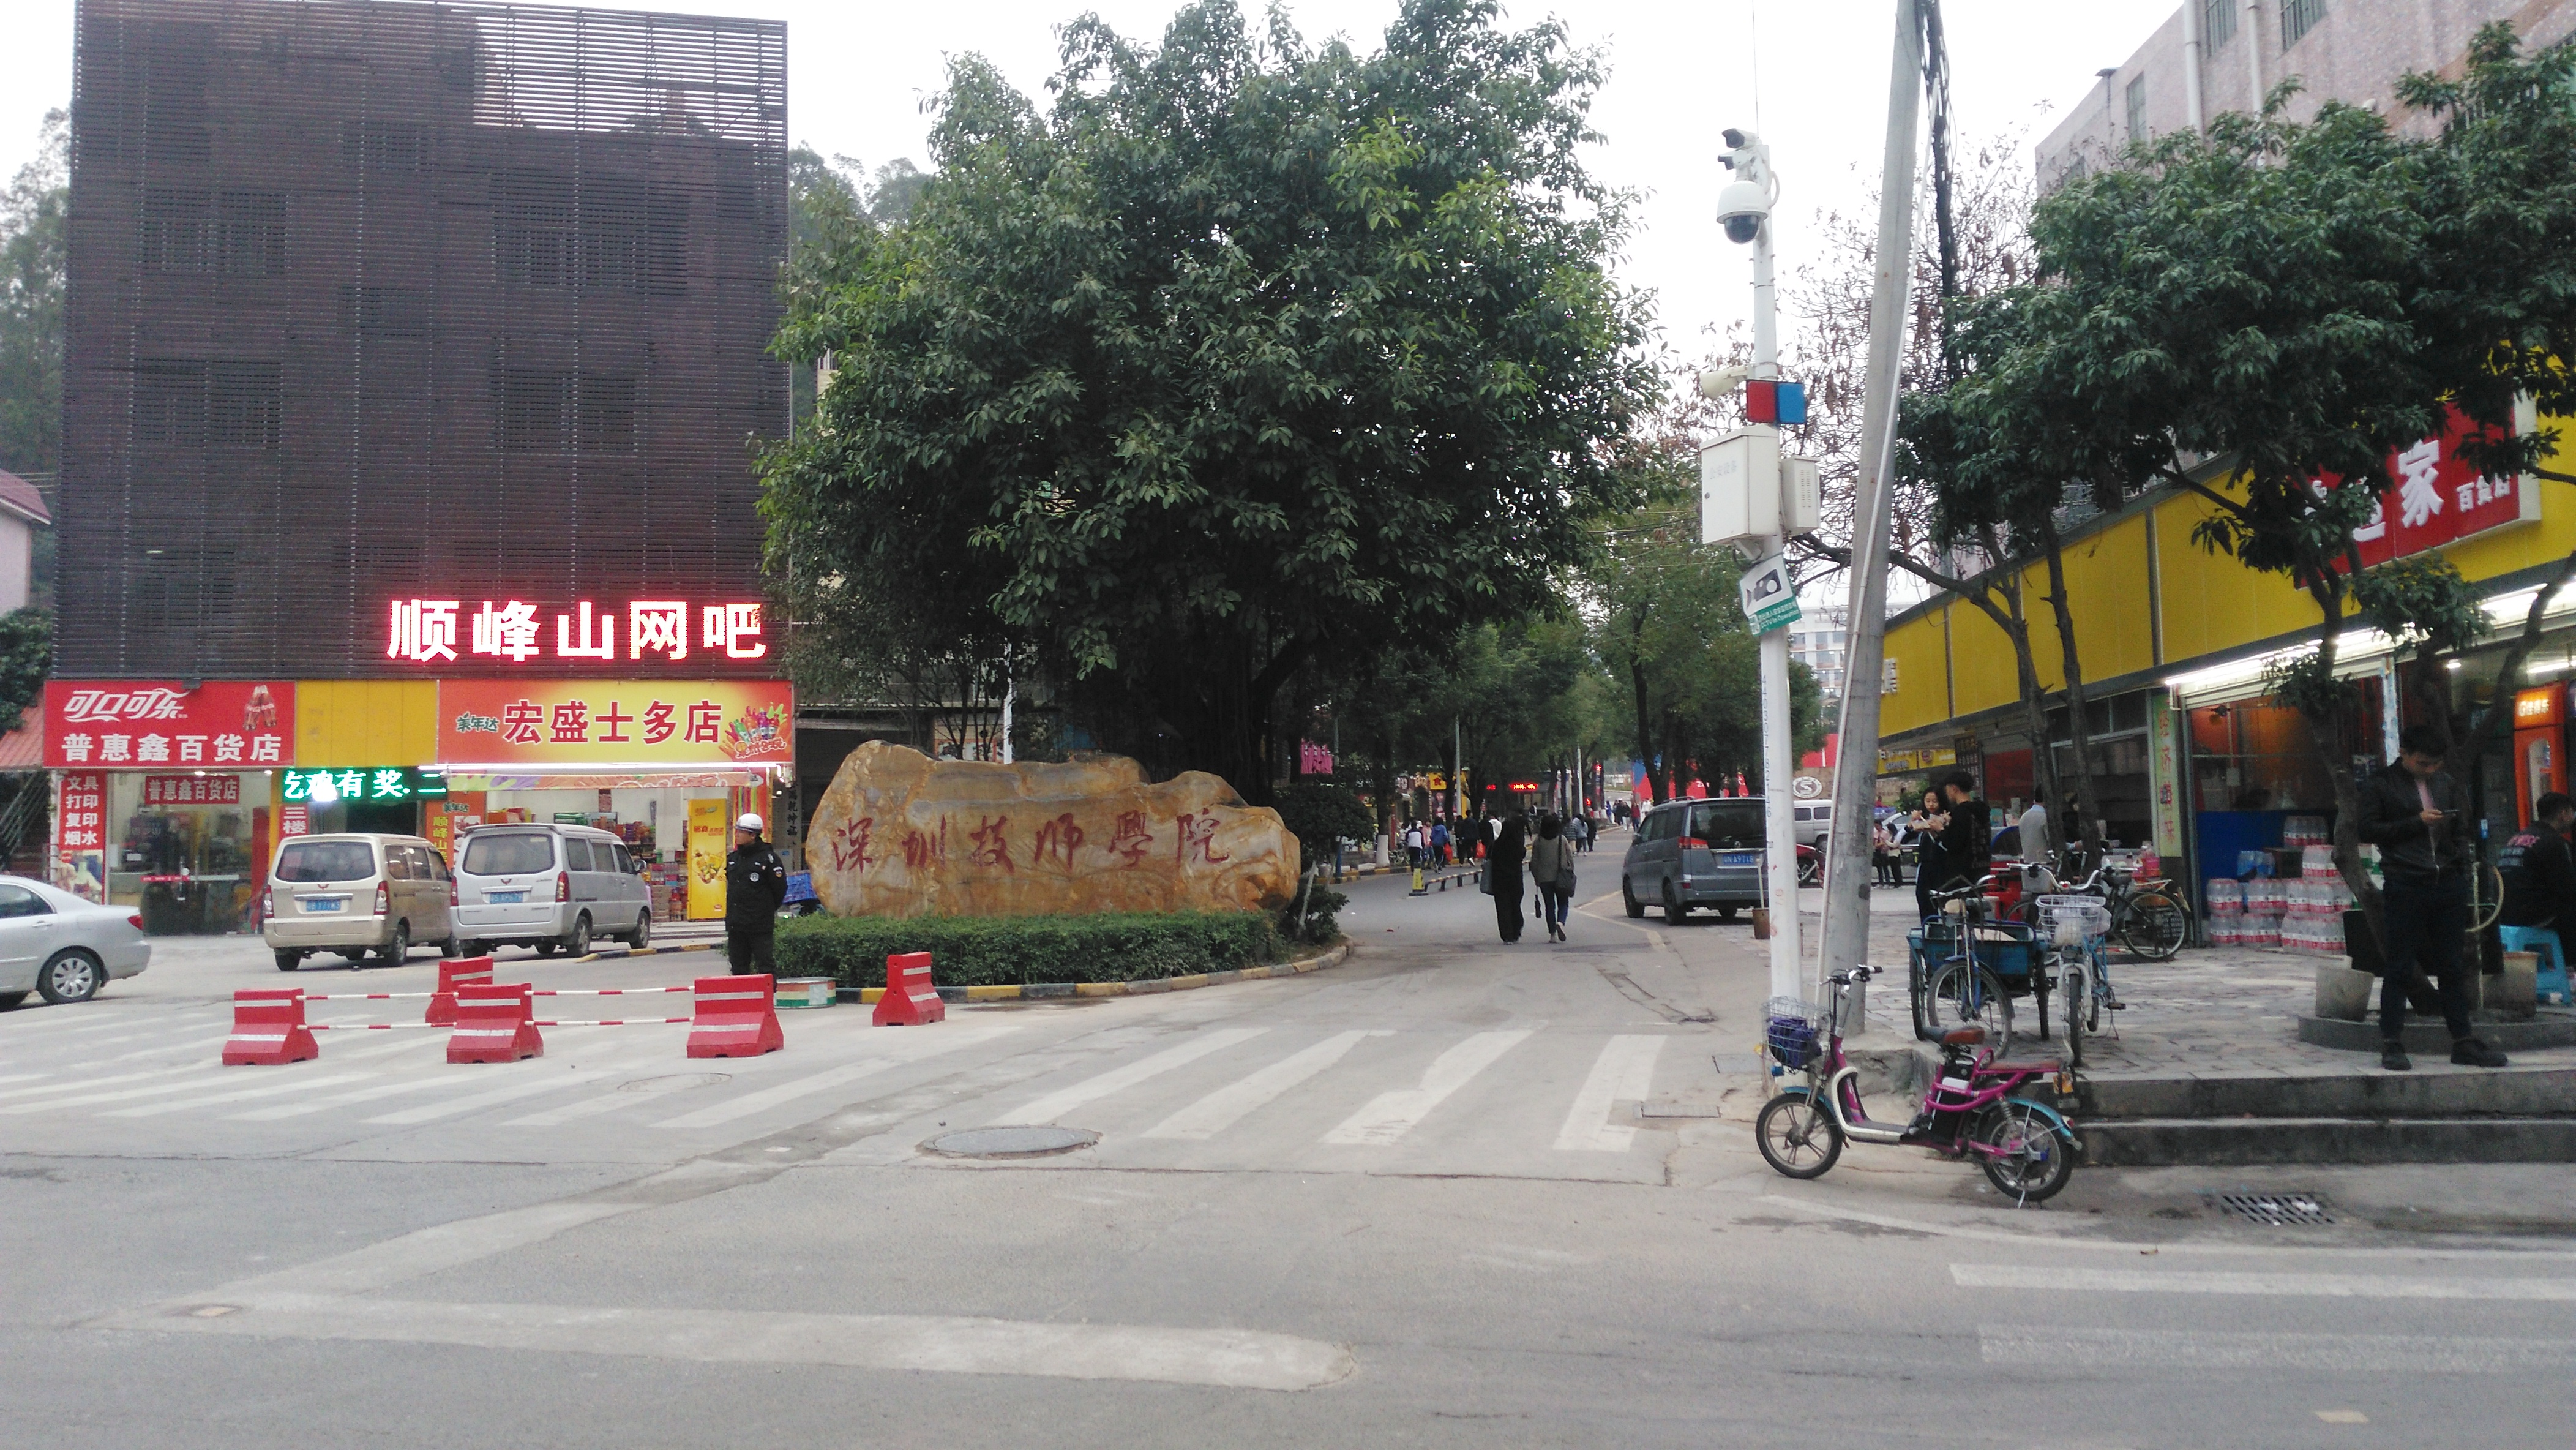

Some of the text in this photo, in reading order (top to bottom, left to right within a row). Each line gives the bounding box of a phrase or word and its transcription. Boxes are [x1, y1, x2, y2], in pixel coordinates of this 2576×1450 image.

[387, 599, 766, 662] 顺峰山网吧
[63, 688, 190, 722] 可口可乐
[456, 712, 498, 732] 美年达
[503, 699, 722, 745] 宏盛士多店
[62, 733, 282, 762] 普惠鑫百货店
[67, 776, 99, 791] 文具
[149, 779, 238, 801] 普惠鑫百货店
[66, 794, 98, 810] 打印
[66, 813, 98, 827] 复印
[283, 806, 307, 834] 三楼
[64, 830, 97, 845] 烟水
